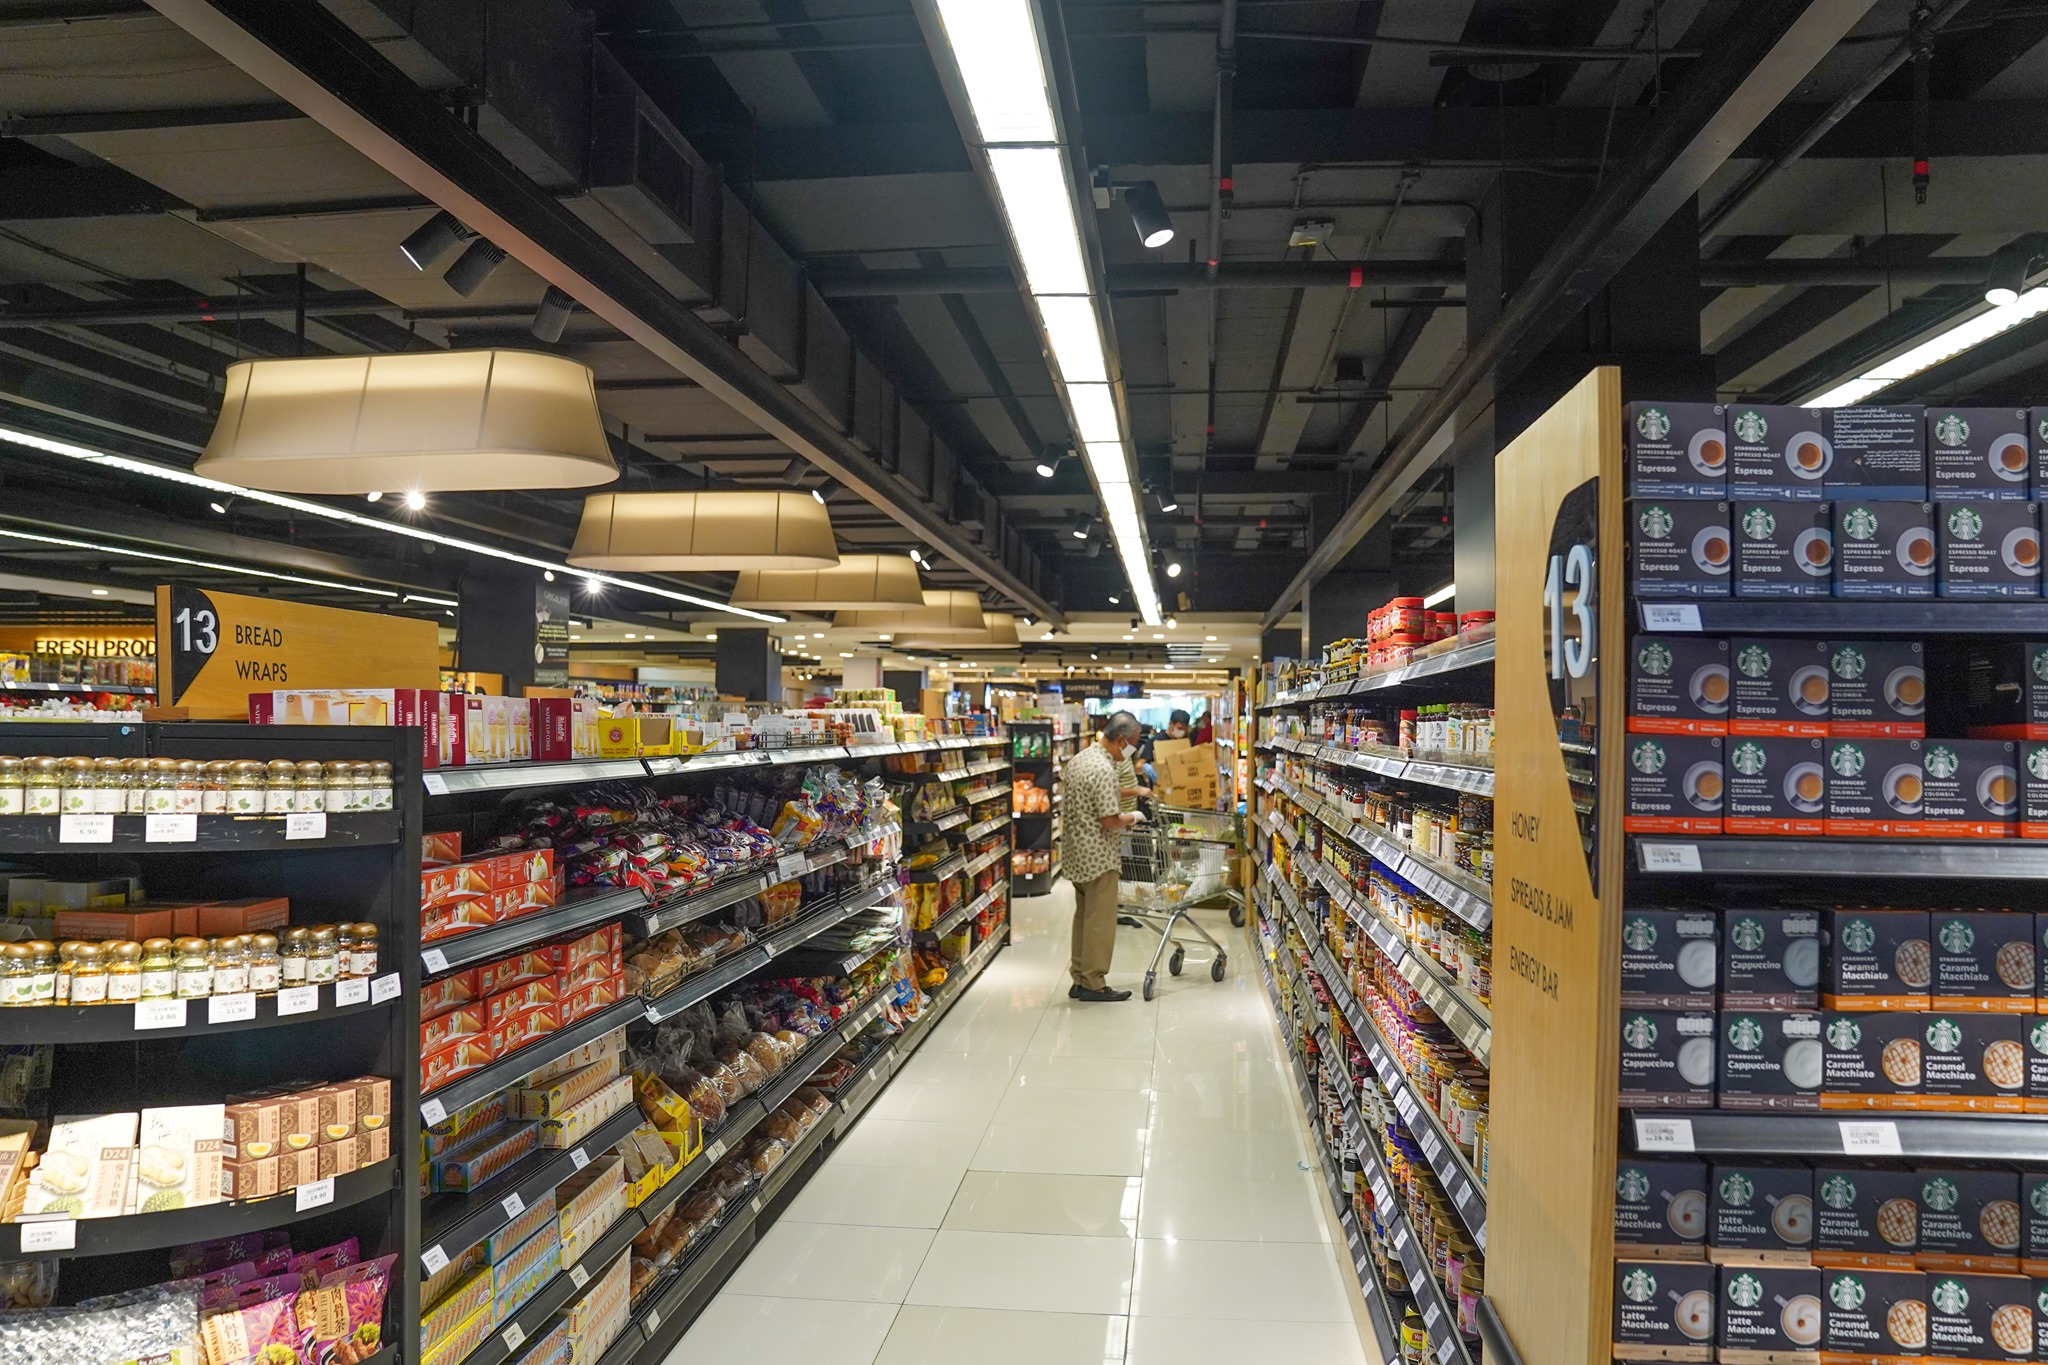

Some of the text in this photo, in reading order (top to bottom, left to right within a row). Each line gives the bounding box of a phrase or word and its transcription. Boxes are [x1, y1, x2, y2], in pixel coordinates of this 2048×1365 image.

[1638, 464, 1677, 475] Espresso
[1735, 467, 1773, 476] Espresso
[1936, 470, 1976, 480] Espresso
[1640, 563, 1679, 572] Espresso
[1743, 564, 1782, 573] Espresso
[1844, 564, 1884, 573] Espresso
[1950, 565, 1989, 573] Espresso
[1544, 544, 1594, 680] 13
[176, 608, 216, 653] 13
[236, 625, 282, 647] BREAD
[34, 640, 98, 656] FRESH
[236, 660, 287, 682] WRAPS
[1637, 702, 1677, 712] Espresso
[1737, 705, 1776, 714] Espresso
[1832, 707, 1872, 716] Espresso
[1632, 802, 1671, 811] Espresso
[1732, 803, 1771, 812] Espresso
[1831, 805, 1871, 814] Espresso
[1925, 806, 1964, 815] Espresso
[1512, 811, 1540, 843] HONEY
[1511, 877, 1573, 932] SPREADS & JAM
[1623, 961, 1674, 971] Cappuccino
[1731, 962, 1781, 970] Cappuccino
[1842, 963, 1878, 971] Caramel
[1940, 964, 1978, 972] Caramel
[1511, 946, 1558, 1001] ENERGY BAR
[1623, 1060, 1674, 1068] Cappuccino
[1728, 1061, 1780, 1070] Cappuccino
[1826, 1061, 1864, 1069] Caramel
[1926, 1062, 1965, 1071] Caramel
[1827, 1070, 1875, 1078] Macchiato
[1926, 1072, 1976, 1080] Macchiato
[197, 1140, 220, 1151] D24
[103, 1149, 127, 1159] D24
[310, 1192, 326, 1200] 19.90
[1616, 1220, 1662, 1229] Macchiato
[1820, 1218, 1859, 1228] Caramel
[1922, 1220, 1961, 1229] Caramel
[1719, 1225, 1766, 1234] Macchiato
[1820, 1228, 1869, 1237] Macchiato
[1922, 1230, 1972, 1239] Macchiato
[331, 1287, 346, 1333] 肉骨茶
[1622, 1320, 1669, 1330] Macchiato
[1728, 1317, 1751, 1325] Latte
[1829, 1319, 1869, 1329] Caramel
[1728, 1326, 1775, 1335] Macchiato
[1830, 1329, 1879, 1338] Macchiato
[1932, 1324, 1972, 1334] Caramel
[1932, 1334, 1984, 1344] Macchiato
